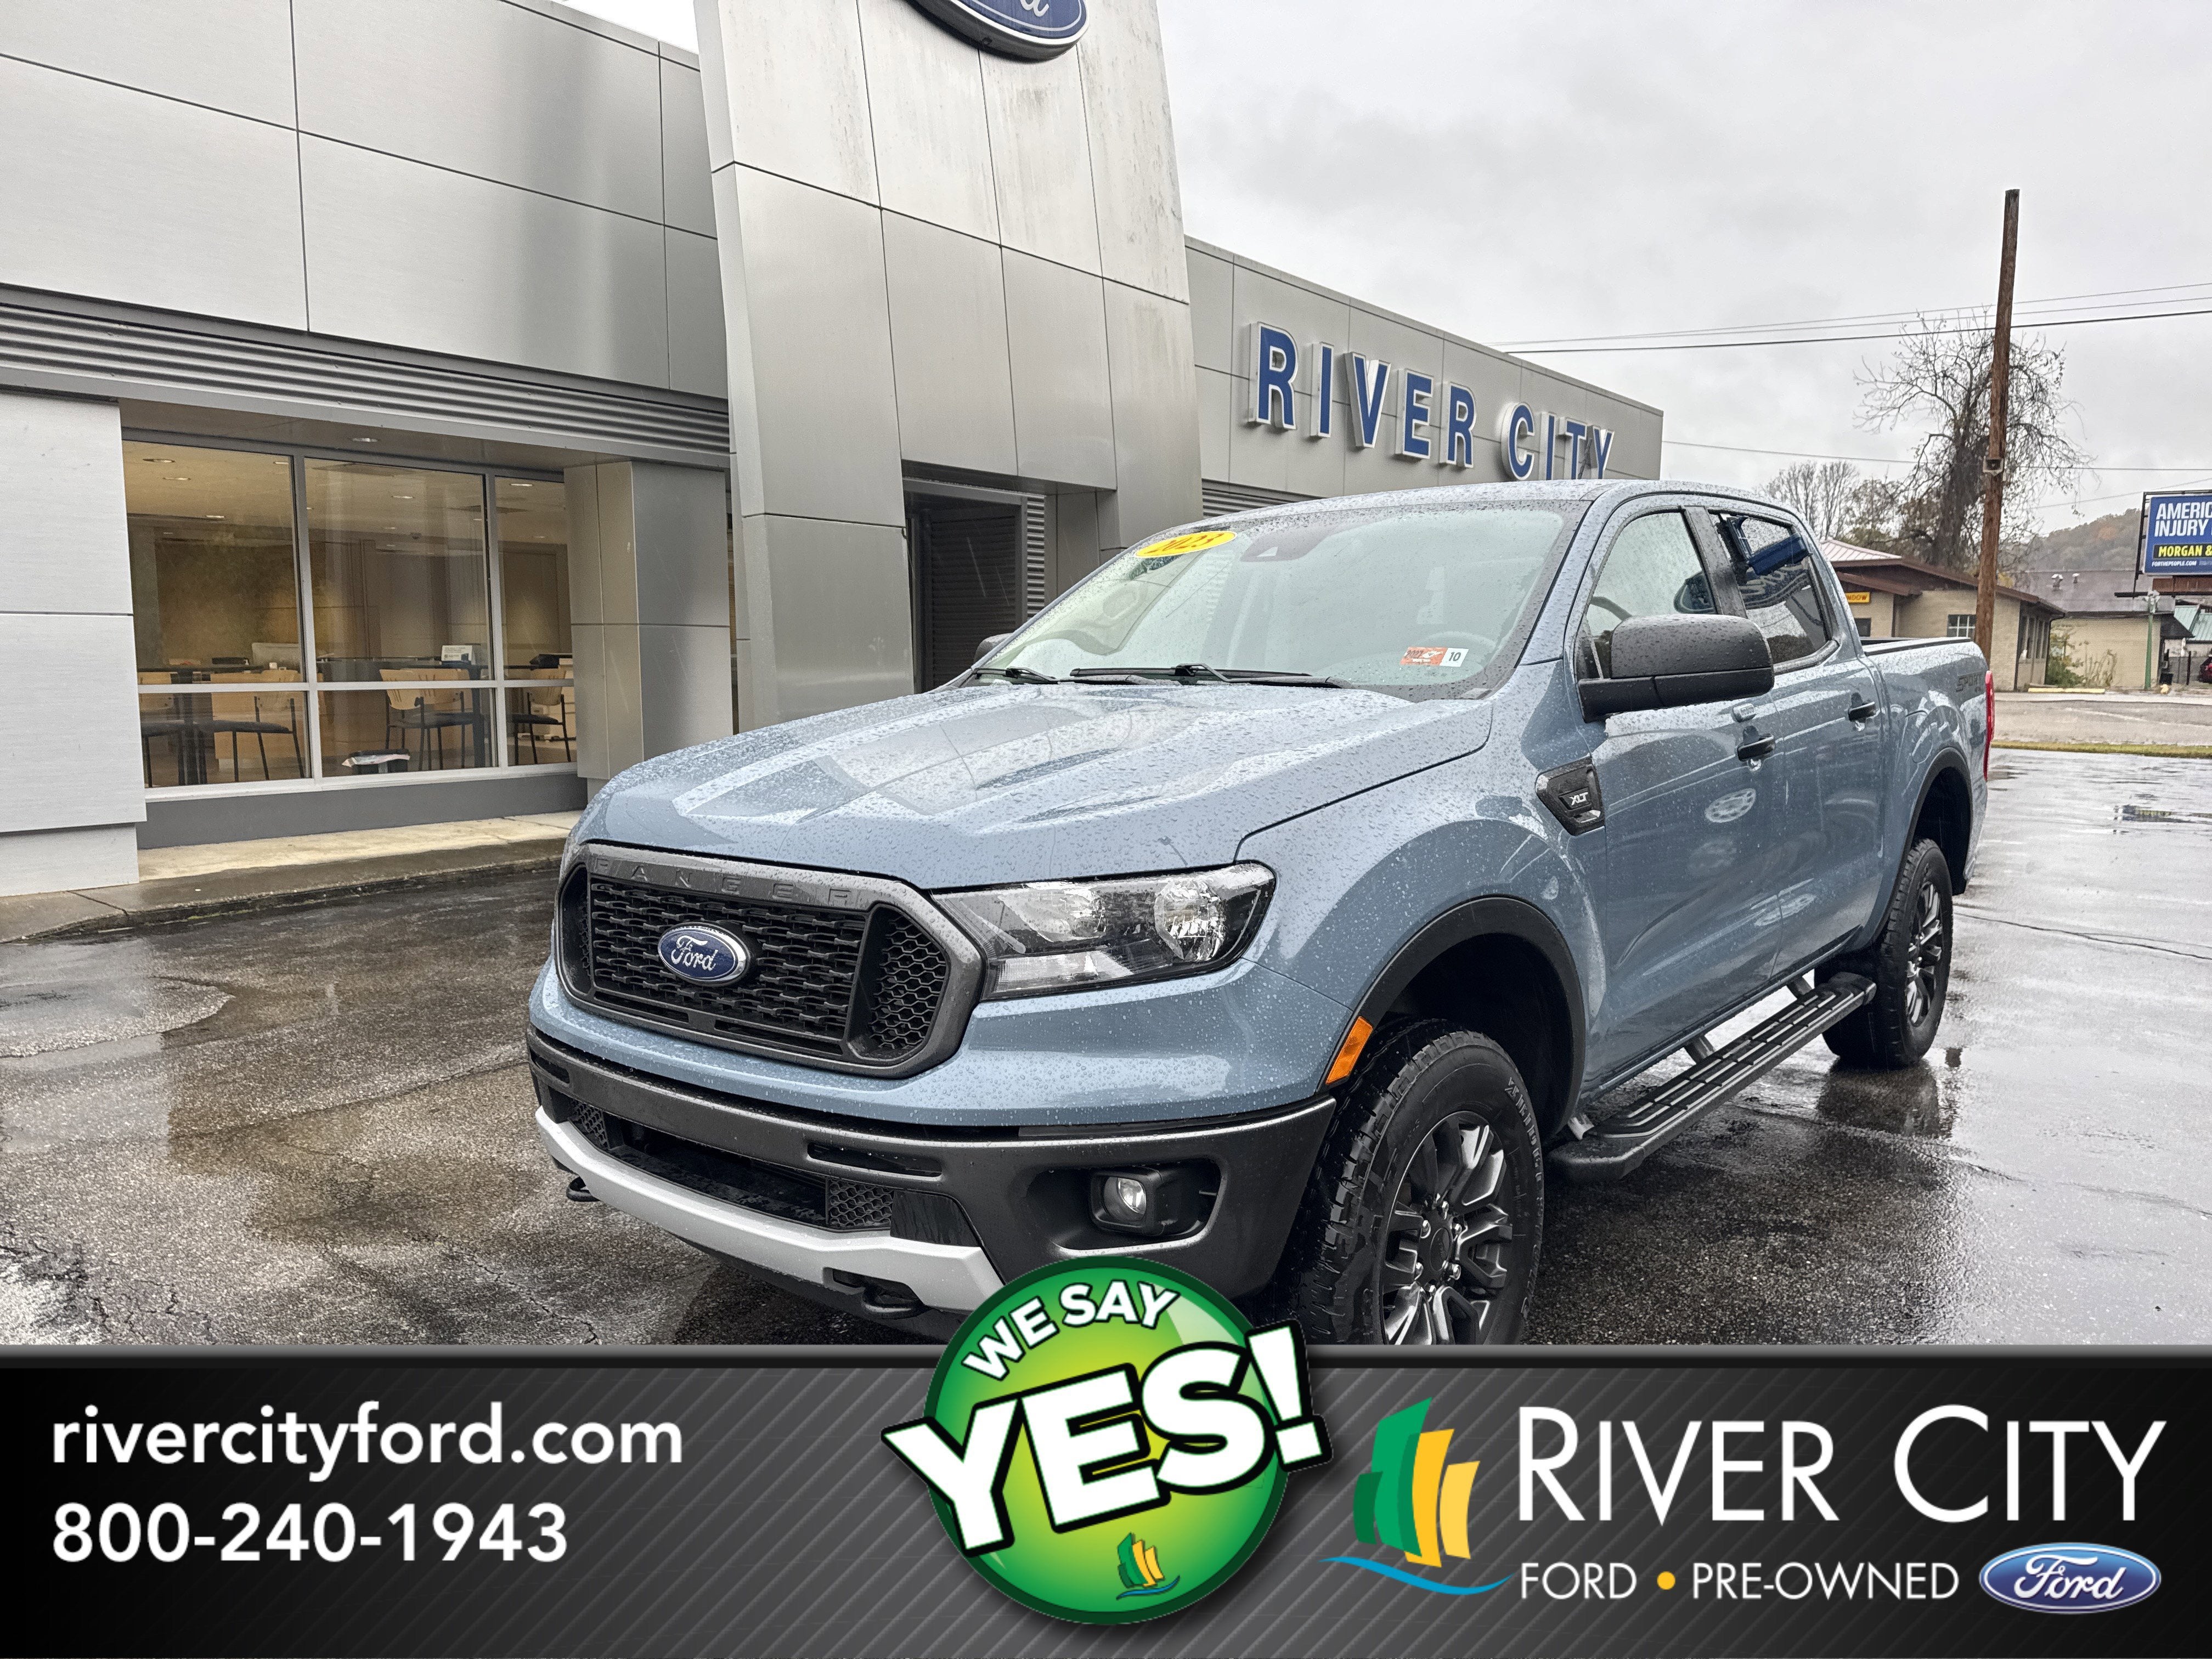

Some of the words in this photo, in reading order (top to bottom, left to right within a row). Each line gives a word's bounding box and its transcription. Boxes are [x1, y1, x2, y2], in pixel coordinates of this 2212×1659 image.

[1250, 321, 1477, 468] RIVER
[1503, 402, 1615, 481] CITY
[2154, 518, 2209, 537] INJURY
[2158, 545, 2203, 557] MORGAN
[1448, 652, 1462, 662] 10
[1569, 792, 1589, 806] XLT
[595, 857, 853, 907] RANGER
[671, 935, 719, 971] Ford
